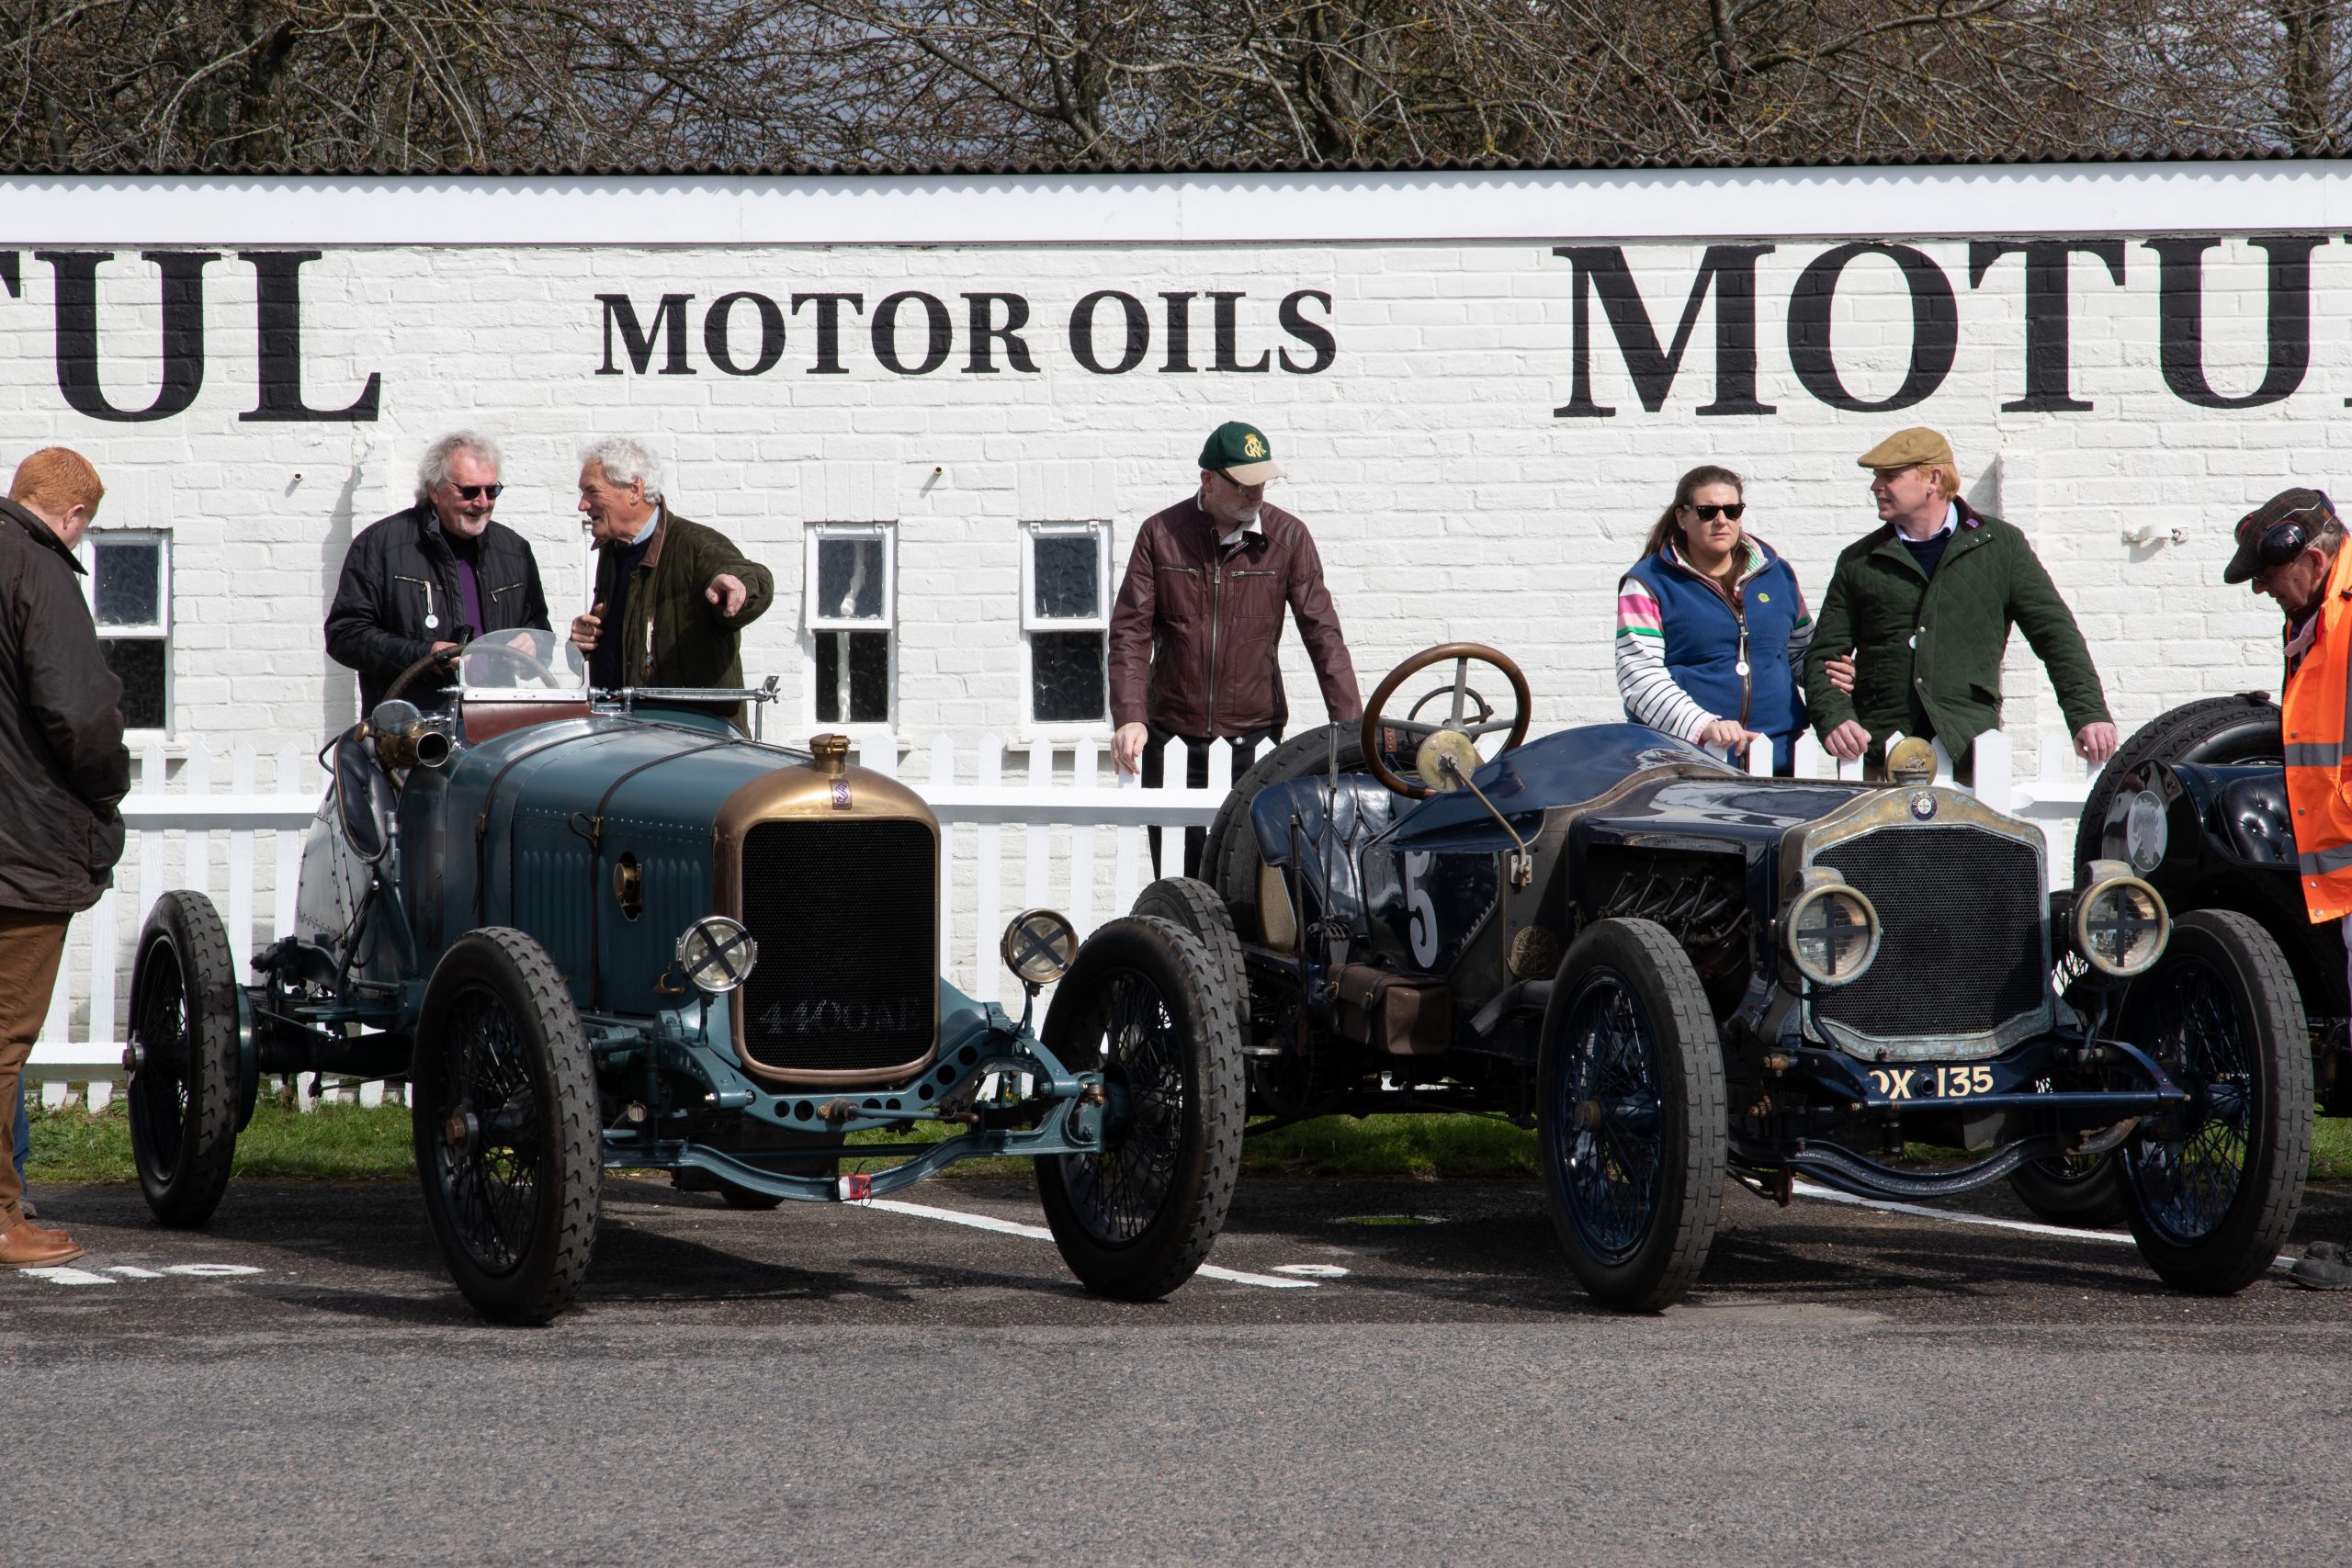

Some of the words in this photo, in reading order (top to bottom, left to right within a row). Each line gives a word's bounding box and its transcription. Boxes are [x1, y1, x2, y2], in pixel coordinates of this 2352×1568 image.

[0, 249, 381, 423] UL
[594, 289, 1041, 376] MOTOR
[1069, 288, 1336, 375] OILS
[1553, 236, 2352, 418] MOTU
[1405, 851, 1438, 968] 5
[1938, 1066, 1994, 1098] 135
